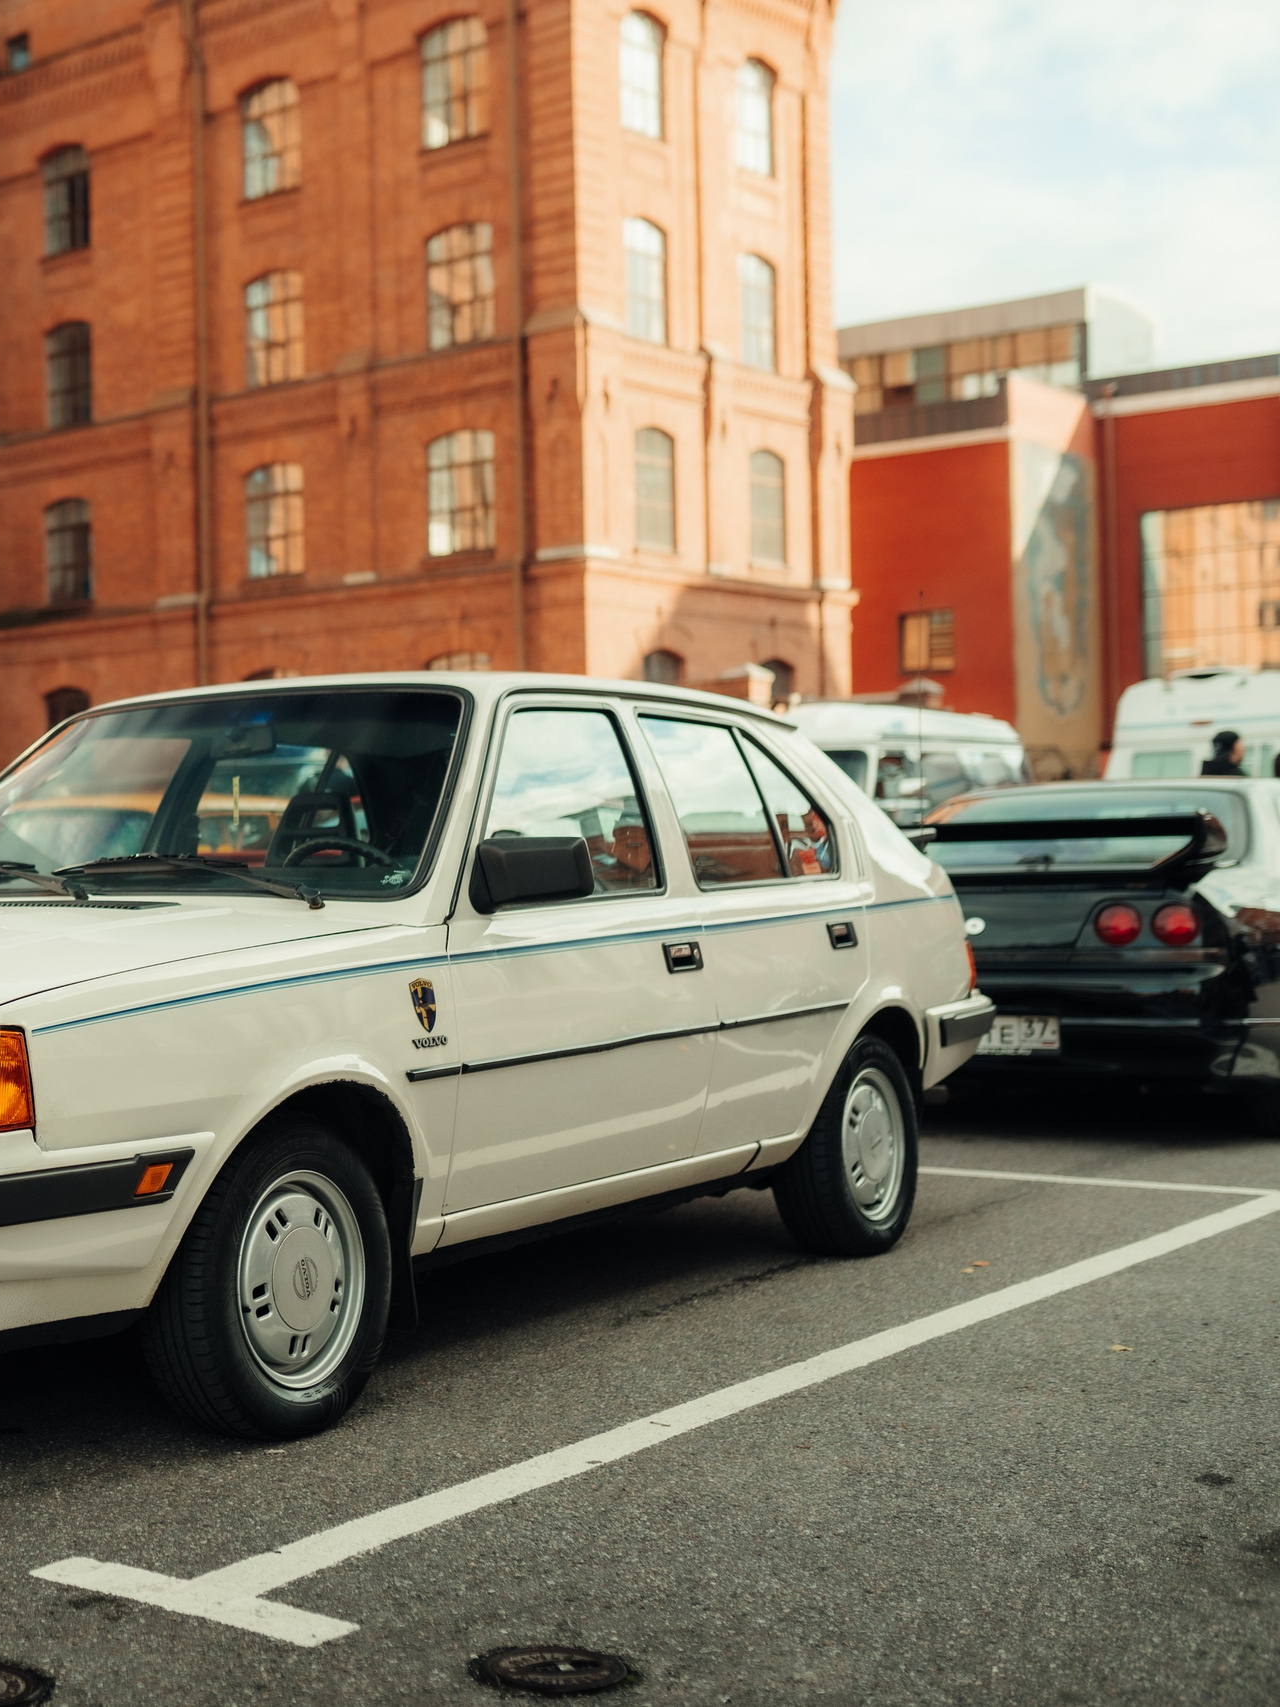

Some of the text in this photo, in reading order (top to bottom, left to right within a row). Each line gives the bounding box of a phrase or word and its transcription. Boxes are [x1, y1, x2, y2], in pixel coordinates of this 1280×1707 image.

[411, 980, 432, 989] VOLVO
[1023, 1016, 1050, 1039] 37
[412, 1035, 448, 1049] VOLVO
[300, 1258, 311, 1300] VOLVO
